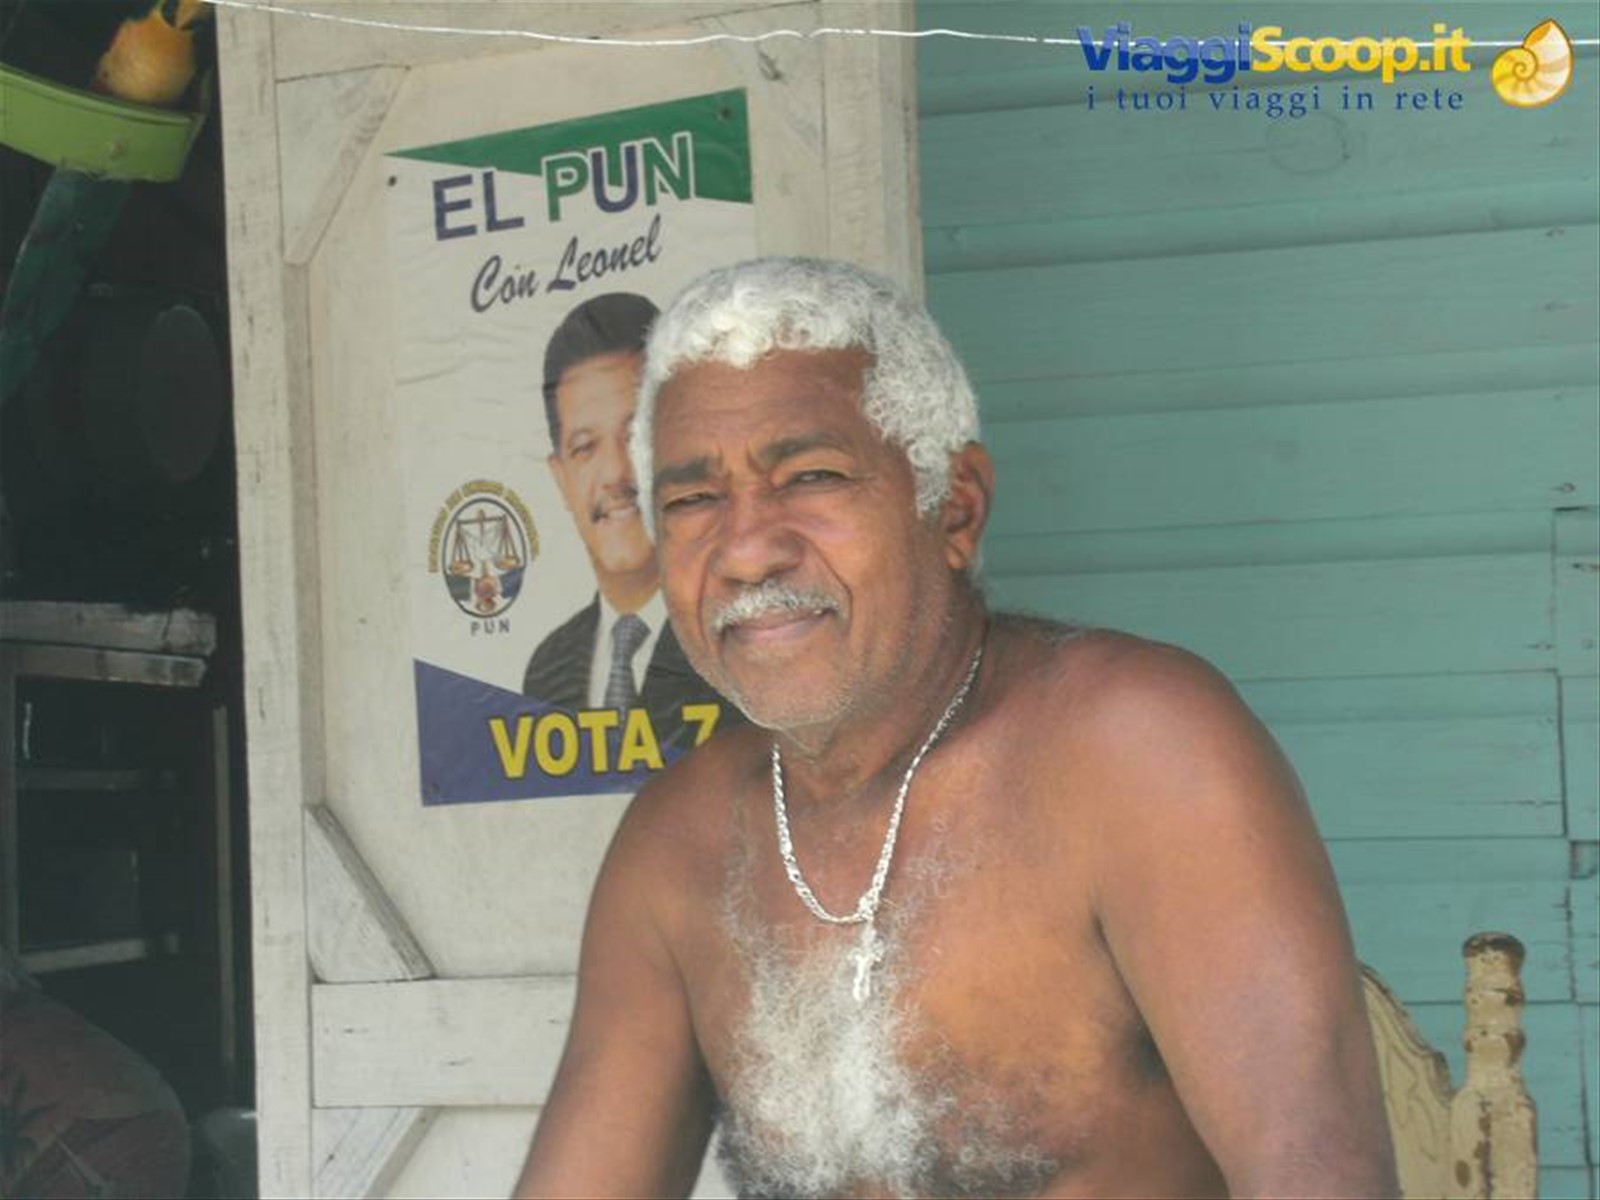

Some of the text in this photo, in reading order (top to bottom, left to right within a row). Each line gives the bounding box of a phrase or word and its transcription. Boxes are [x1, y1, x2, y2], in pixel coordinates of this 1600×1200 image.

[432, 131, 695, 242] EL PUN
[470, 214, 663, 313] Con Leonel
[470, 618, 510, 635] PUN
[489, 708, 665, 779] VOTA
